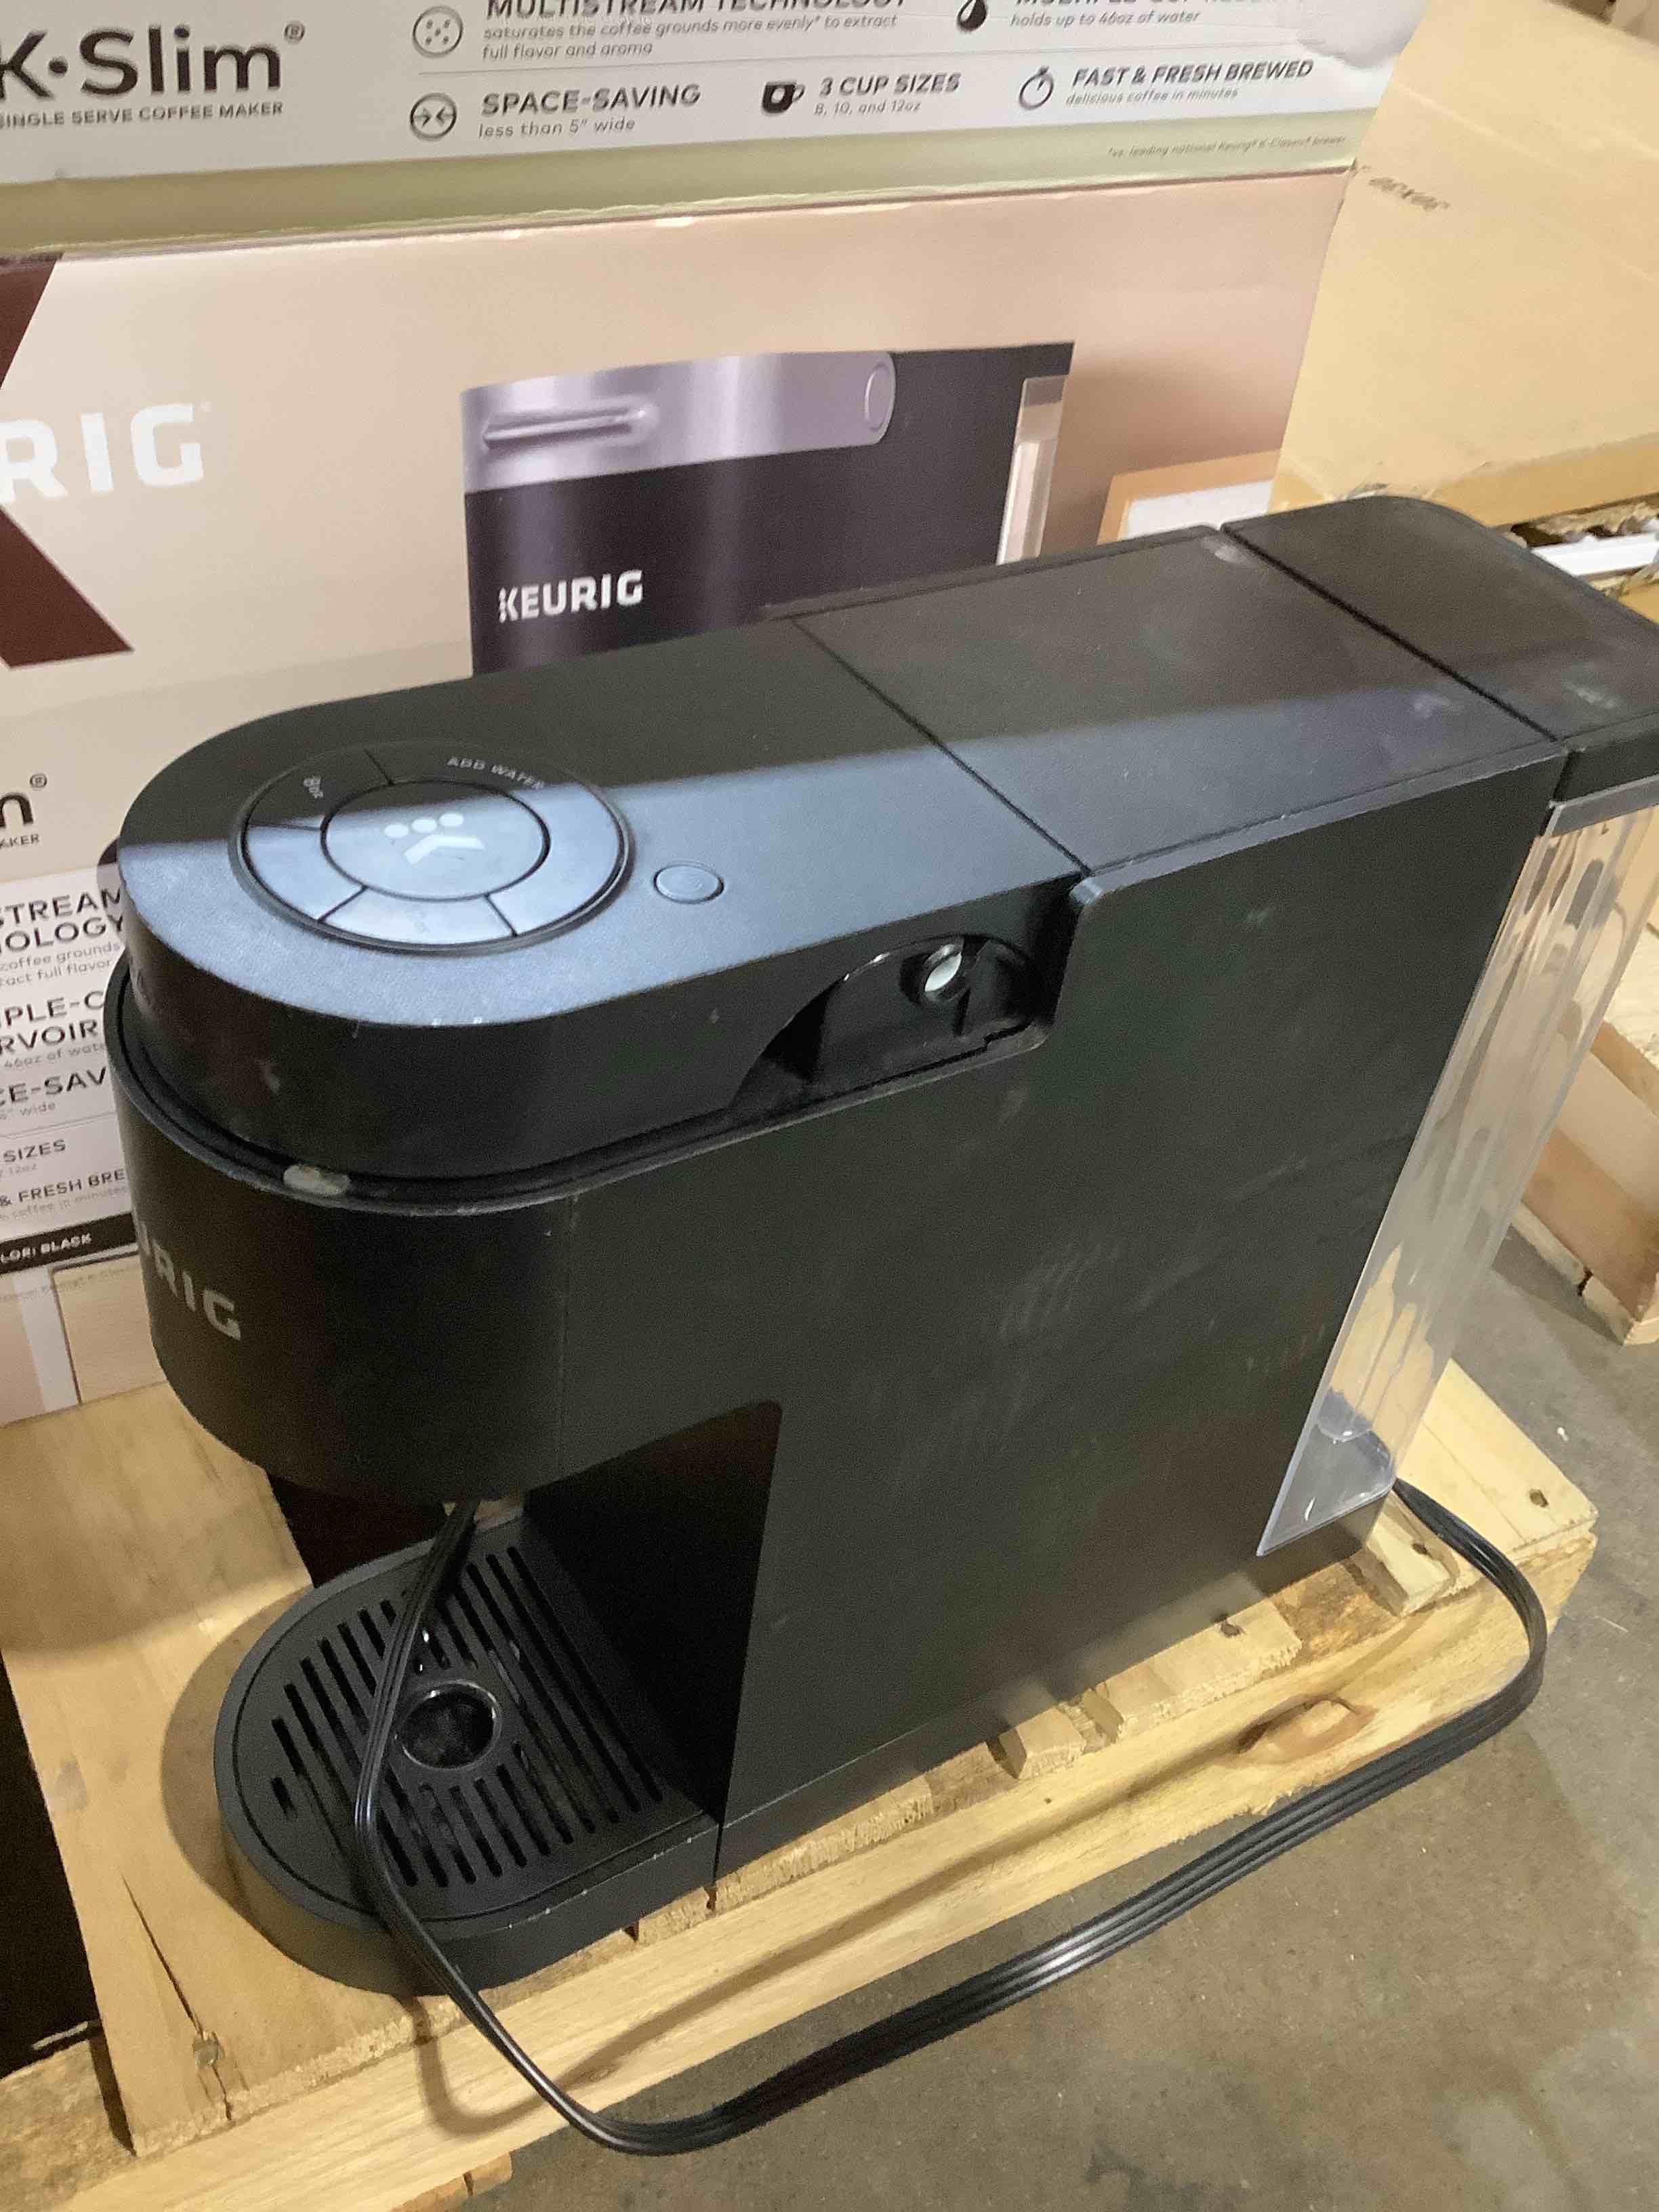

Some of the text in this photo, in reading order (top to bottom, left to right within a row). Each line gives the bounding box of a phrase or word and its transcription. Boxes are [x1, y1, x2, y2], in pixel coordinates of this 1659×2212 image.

[484, 24, 564, 40] saturates
[569, 24, 596, 37] the
[600, 20, 651, 35] coffee
[656, 18, 719, 38] grounds
[723, 19, 763, 31] more
[825, 15, 840, 28] to
[844, 14, 899, 28] extract
[1008, 14, 1051, 27] holds
[1056, 16, 1075, 29] up
[1079, 14, 1095, 26] to
[1138, 11, 1155, 24] of
[1156, 10, 1202, 23] water
[482, 42, 653, 61] full flavor and aroma
[818, 72, 962, 98] 3 CUP SIZES
[1071, 59, 1315, 88] FAST & FRESH BREWED
[480, 83, 702, 118] SPACE-SAVING
[857, 100, 888, 115] and
[890, 99, 922, 114] 12oz
[1126, 89, 1168, 104] coffee
[1170, 88, 1185, 102] in
[1186, 87, 1240, 101] minutes
[71, 108, 133, 125] SERVE
[138, 104, 213, 121] COFFEE
[219, 101, 284, 118] MAKER
[478, 123, 514, 140] less
[520, 121, 562, 136] than
[594, 115, 636, 132] wide
[498, 569, 643, 623] KEURIG
[447, 757, 486, 771] ADD
[0, 888, 121, 928] TREAM
[0, 914, 123, 954] OLOGY
[56, 941, 121, 964] grounds
[37, 965, 62, 981] full
[66, 960, 112, 975] flavor
[0, 1066, 106, 1107] E-SAV
[3, 1139, 66, 1164] SIZES
[18, 1179, 83, 1203] FRESH
